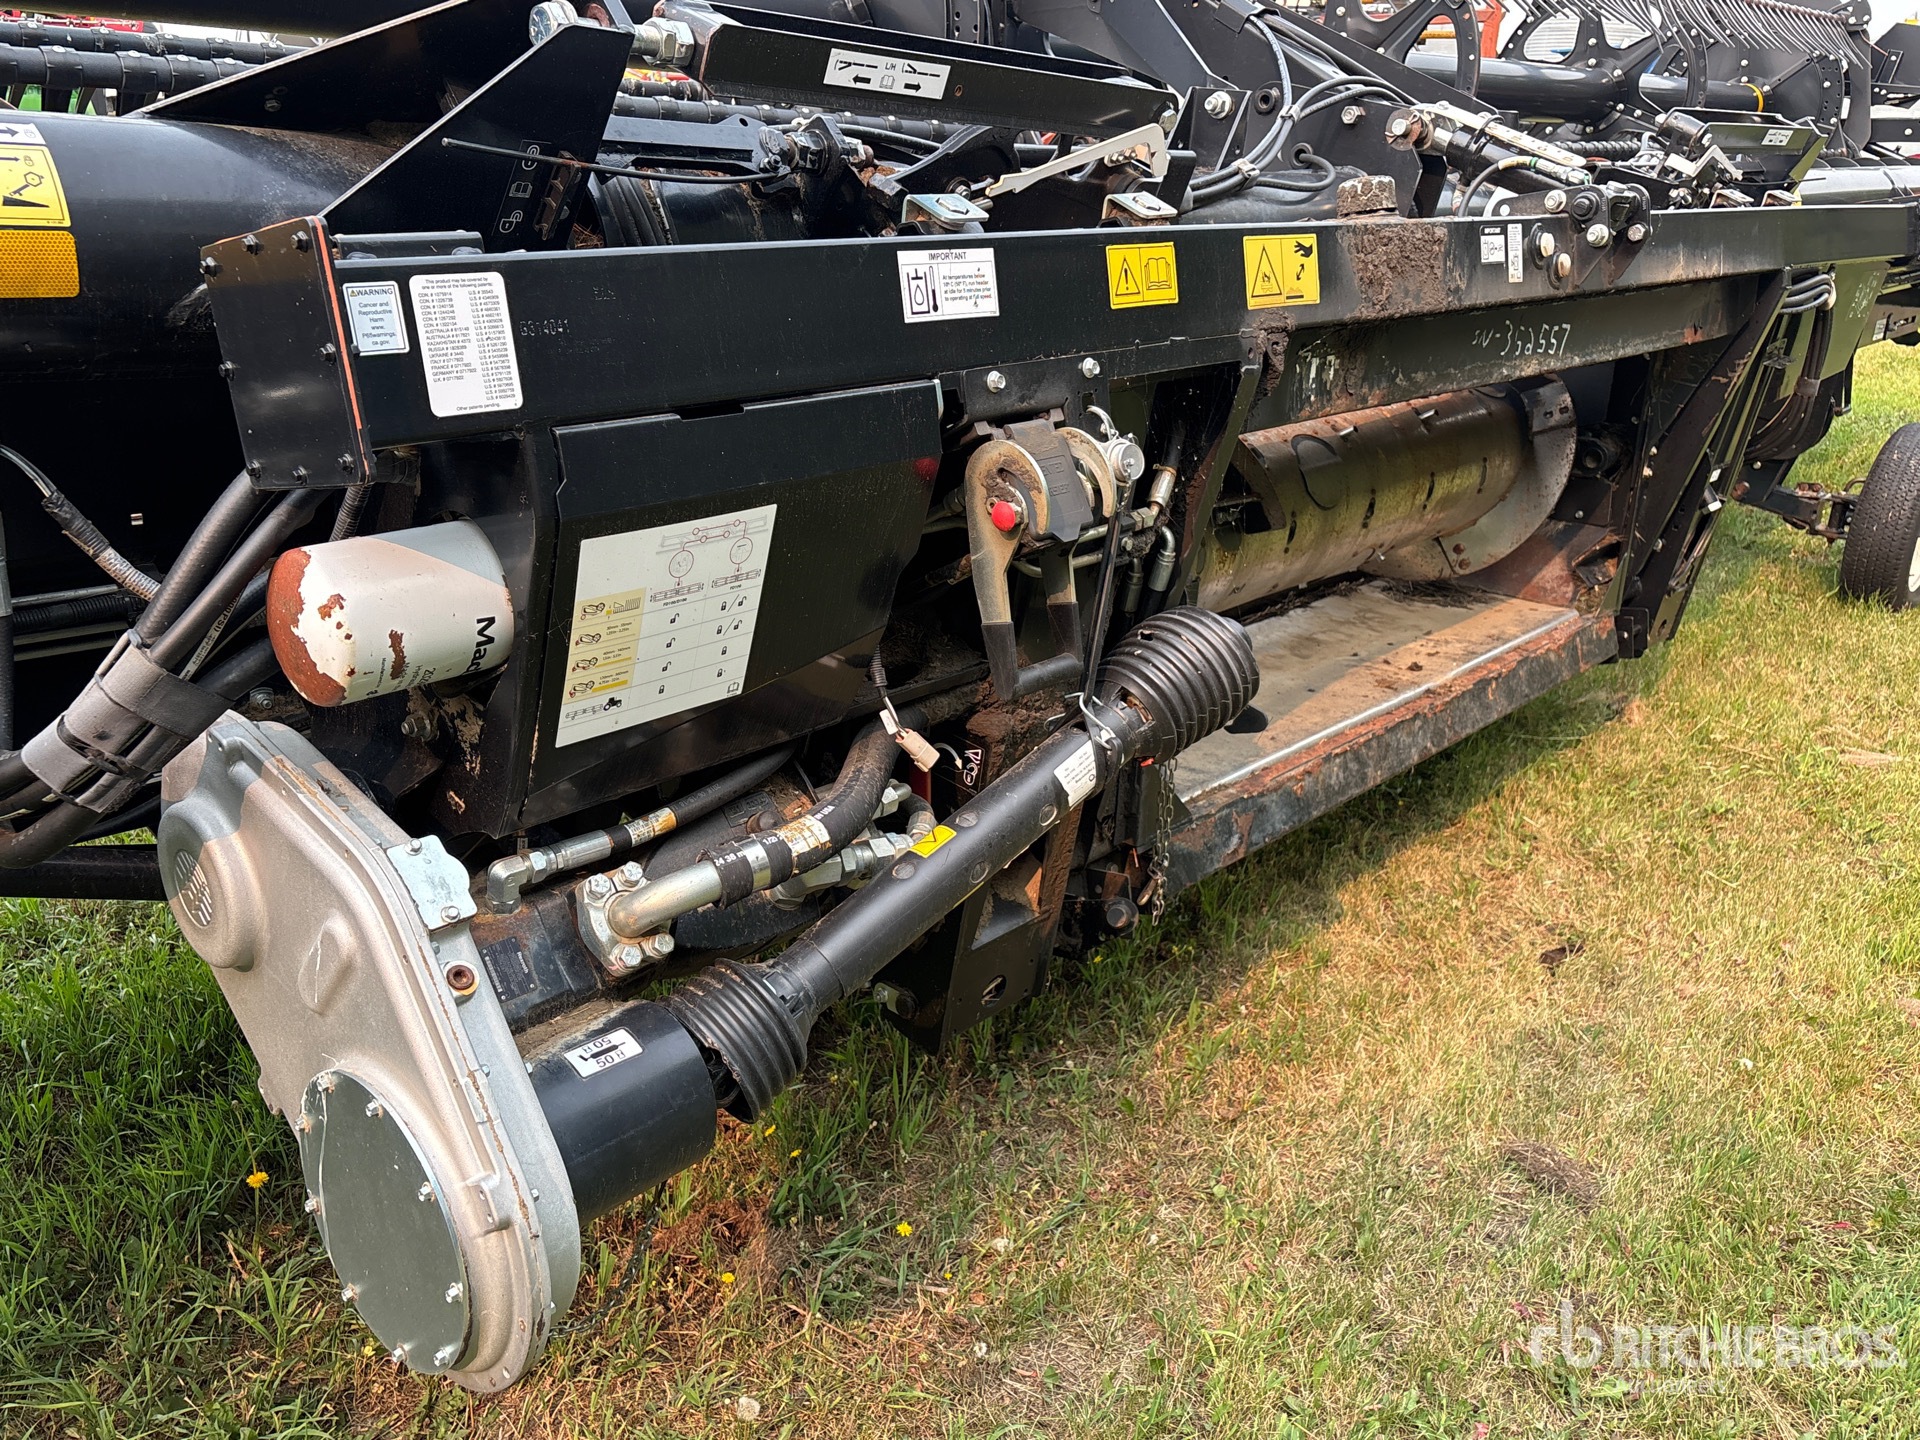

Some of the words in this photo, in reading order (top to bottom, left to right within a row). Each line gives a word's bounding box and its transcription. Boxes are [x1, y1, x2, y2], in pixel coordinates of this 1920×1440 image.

[885, 62, 896, 70] L/H
[929, 252, 967, 261] IMPORTANT
[356, 288, 393, 297] WARNING
[358, 309, 393, 317] Reproductive
[821, 805, 835, 815] USA
[593, 1037, 612, 1048] 50
[596, 1055, 615, 1068] 50
